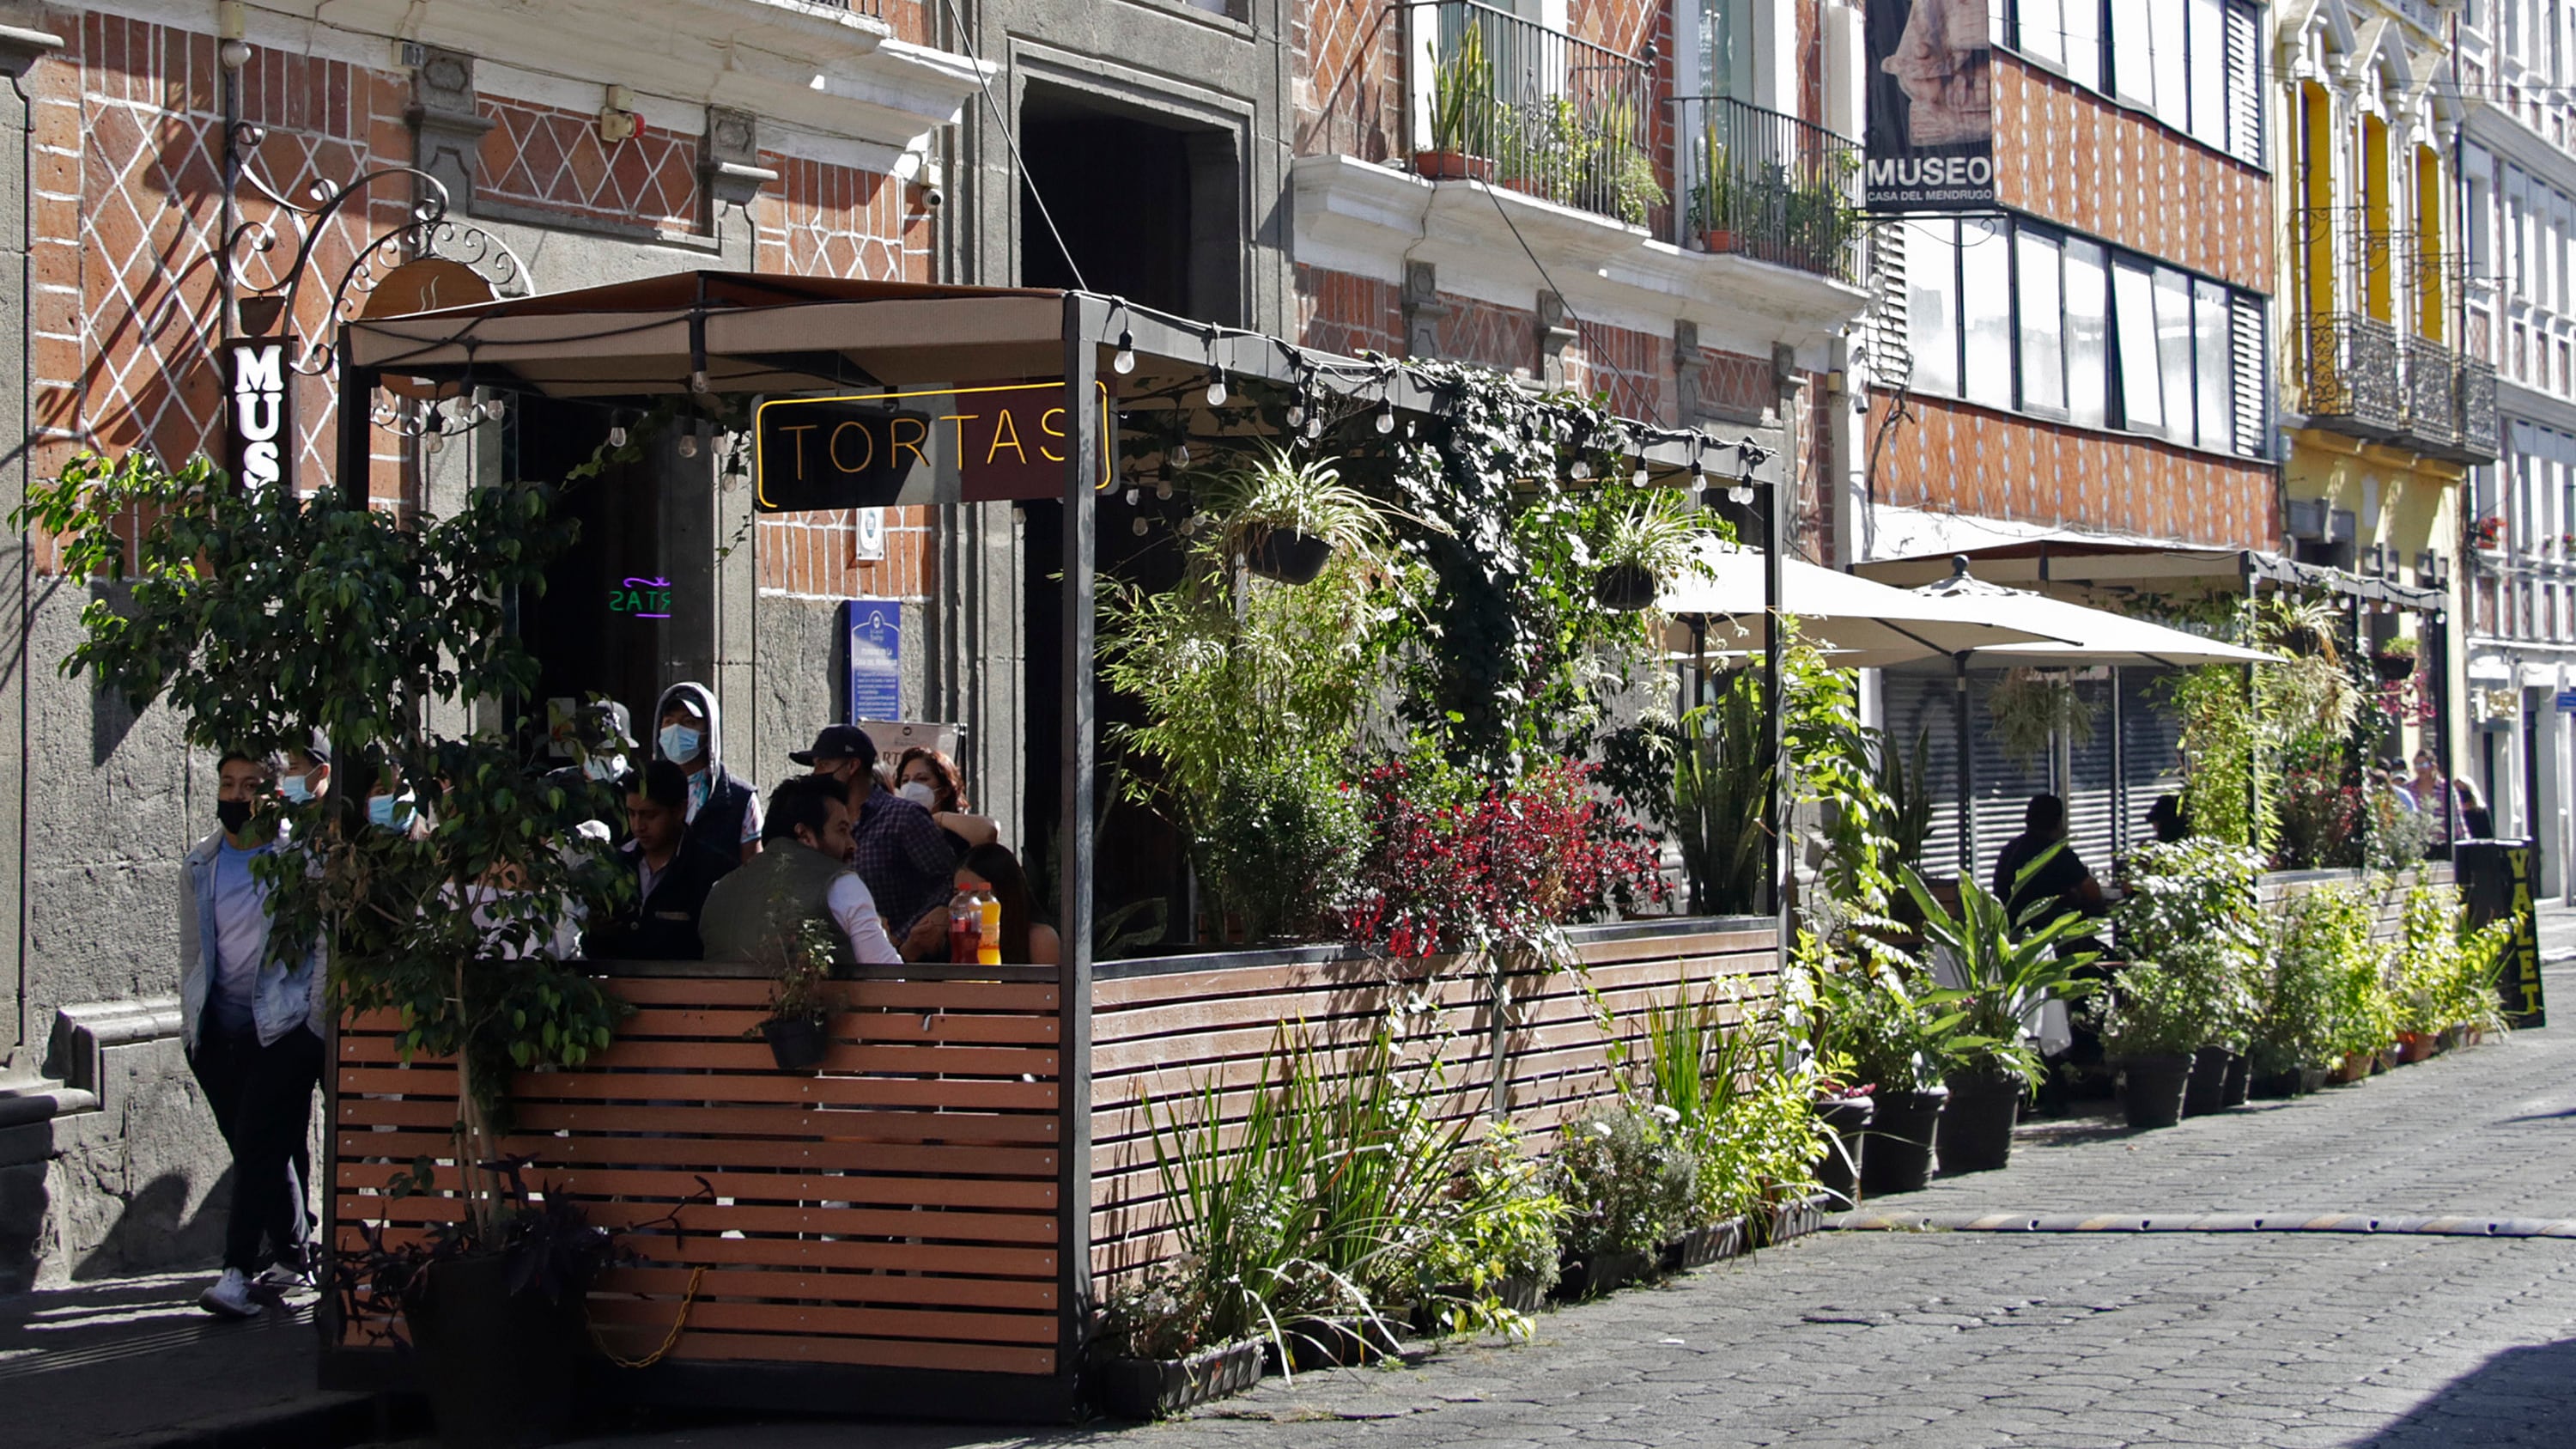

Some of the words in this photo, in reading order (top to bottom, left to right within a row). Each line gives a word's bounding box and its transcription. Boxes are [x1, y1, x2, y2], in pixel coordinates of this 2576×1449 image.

[1867, 157, 1991, 186] MUSEO
[1867, 191, 1898, 202] CASA
[1901, 191, 1923, 201] DEL
[1925, 189, 1992, 201] MENDRUGO
[778, 408, 1066, 481] TORTAS
[2506, 848, 2539, 1014] VALET
